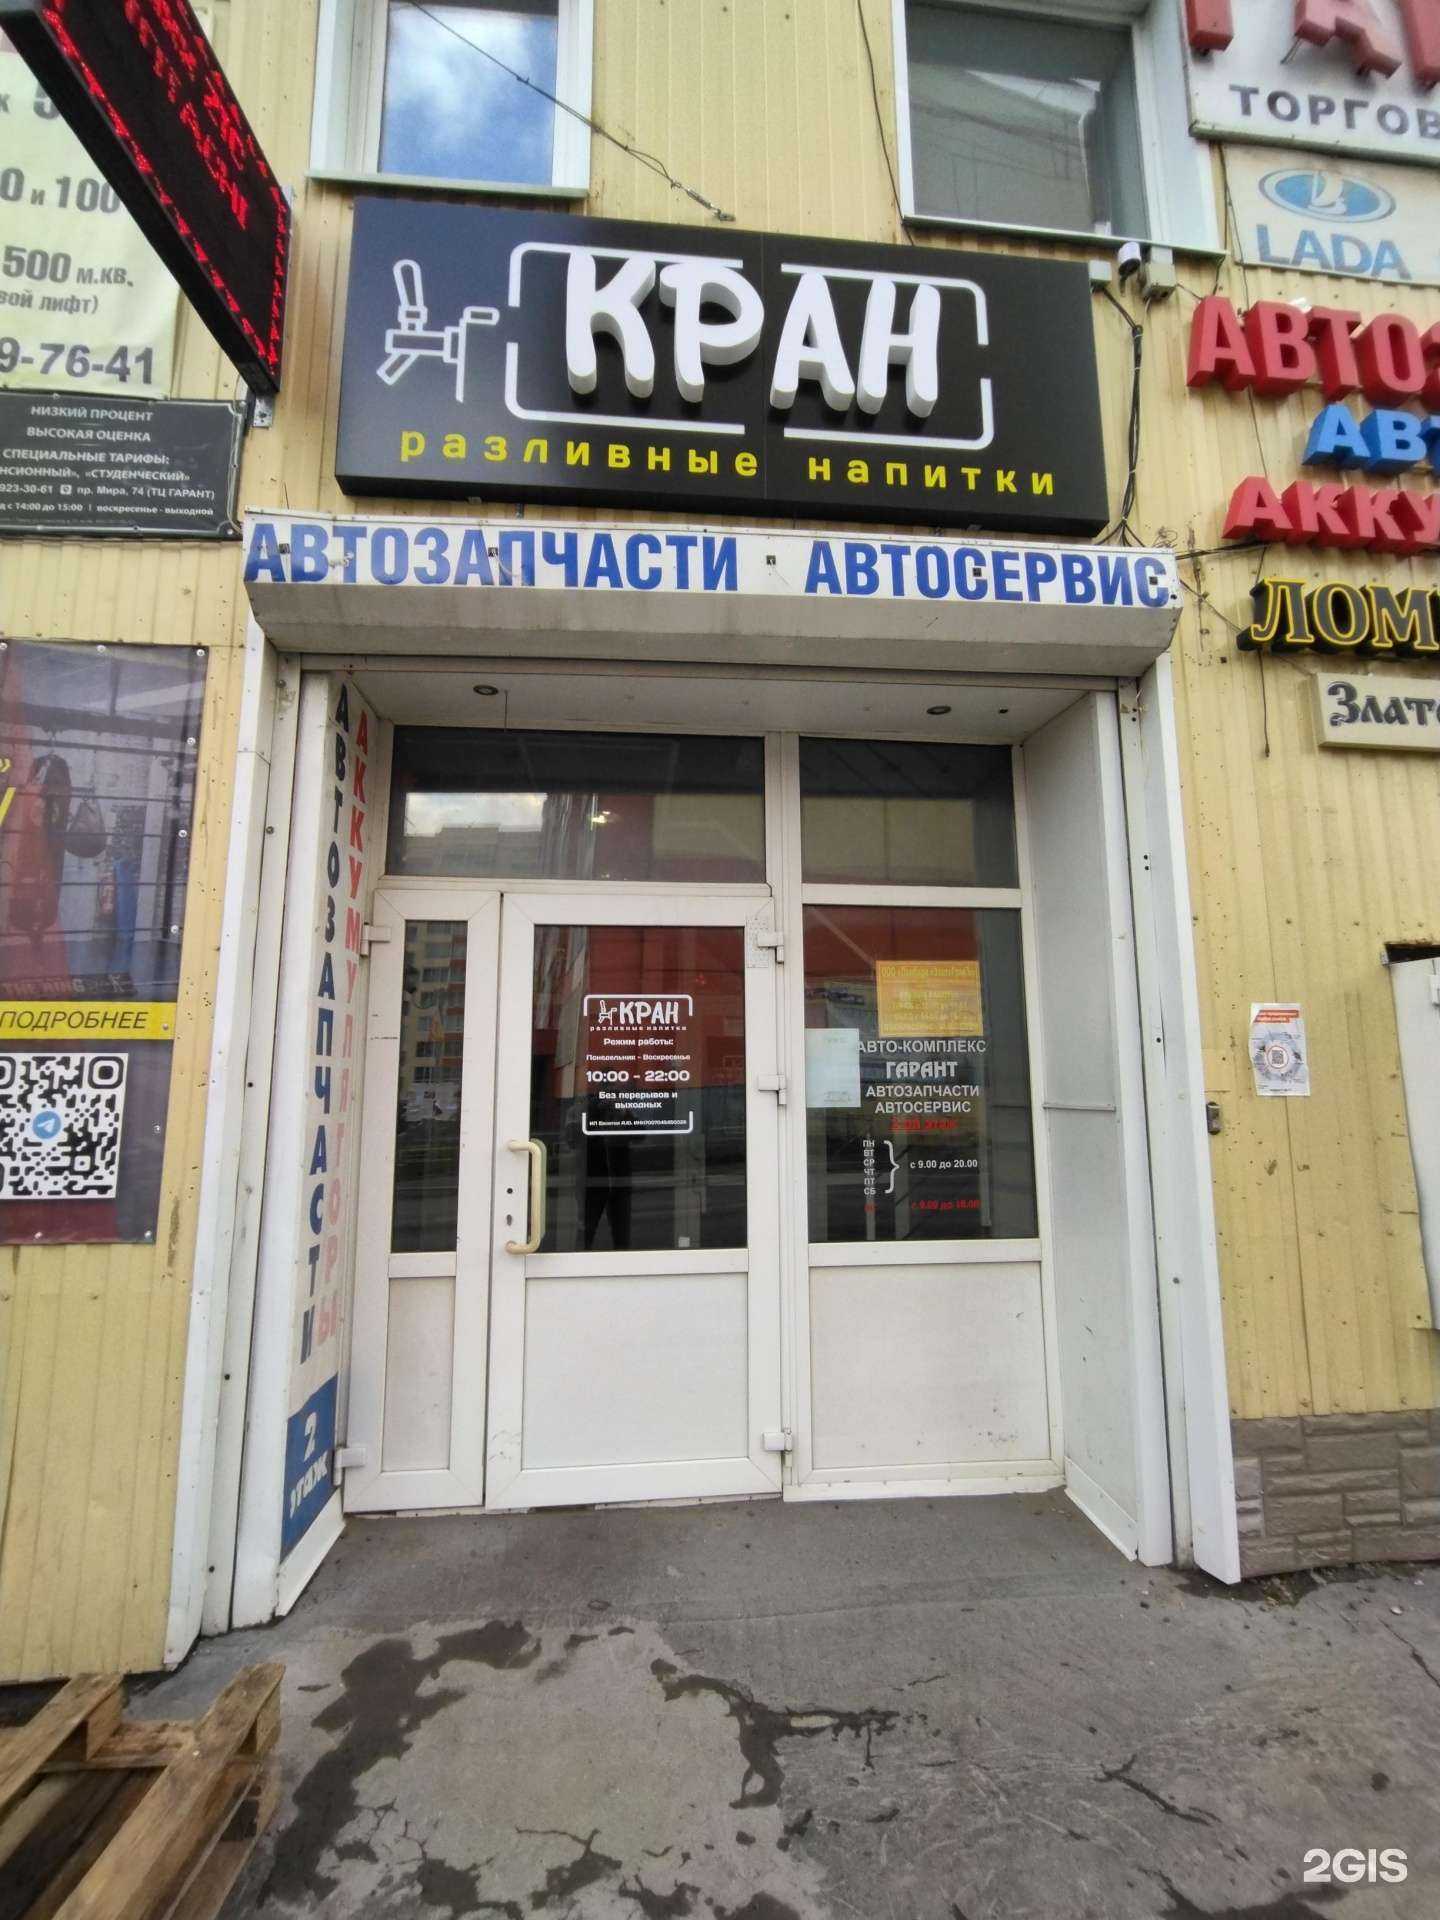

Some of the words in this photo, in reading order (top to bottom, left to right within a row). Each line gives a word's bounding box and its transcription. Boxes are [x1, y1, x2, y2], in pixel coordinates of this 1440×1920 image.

[1229, 84, 1440, 140] ТОРГОВ
[56, 176, 120, 213] 100
[1256, 224, 1411, 281] LADA
[3, 245, 71, 283] 500
[39, 295, 99, 314] лифт)
[565, 251, 941, 418] КРАН
[0, 337, 153, 384] 9-76-41
[1187, 295, 1440, 406] АВТО
[31, 406, 88, 418] НИЗКИЙ
[90, 409, 154, 422] ПРОЦЕНТ
[26, 427, 93, 440] ВЫСОКАЯ
[96, 430, 152, 442] ОЦЕНКА
[2, 448, 107, 462] СПЕЦИАЛЬНЫЕ
[109, 453, 170, 464] ТАРИФЫ:
[400, 428, 759, 478] разливные
[808, 455, 1055, 496] напитки
[131, 486, 145, 495] 74
[168, 488, 215, 500] ГАРАНТ)
[244, 522, 739, 593] АВТОЗАПЧАСТИ
[804, 540, 1168, 608] АВТОСЕРВИС
[1240, 578, 1440, 655] ЛОМ
[1327, 681, 1440, 727] Злат
[0, 1010, 149, 1031] ПОДРОБНЕЕ
[619, 1001, 679, 1024] КРАН
[300, 683, 349, 1365] АВТОЗАПЧАСТИ
[603, 1038, 635, 1046] Режим
[855, 1040, 987, 1053] АВТО-КОМПЛЕКС
[586, 1071, 630, 1082] 10:00
[644, 1070, 690, 1082] 22:00
[886, 1061, 958, 1079] ГАРАНТ
[598, 1091, 616, 1099] Без
[618, 1092, 669, 1100] перерывов
[865, 1085, 980, 1098] АВТОЗАПЧАСТИ
[874, 1101, 972, 1114] АВТОСЕРВИС
[863, 1140, 875, 1148] ПН
[863, 1159, 875, 1167] СР
[918, 1160, 937, 1169] 9.00
[939, 1162, 952, 1170] до
[953, 1160, 978, 1168] 20.00
[303, 1412, 317, 1463] 2
